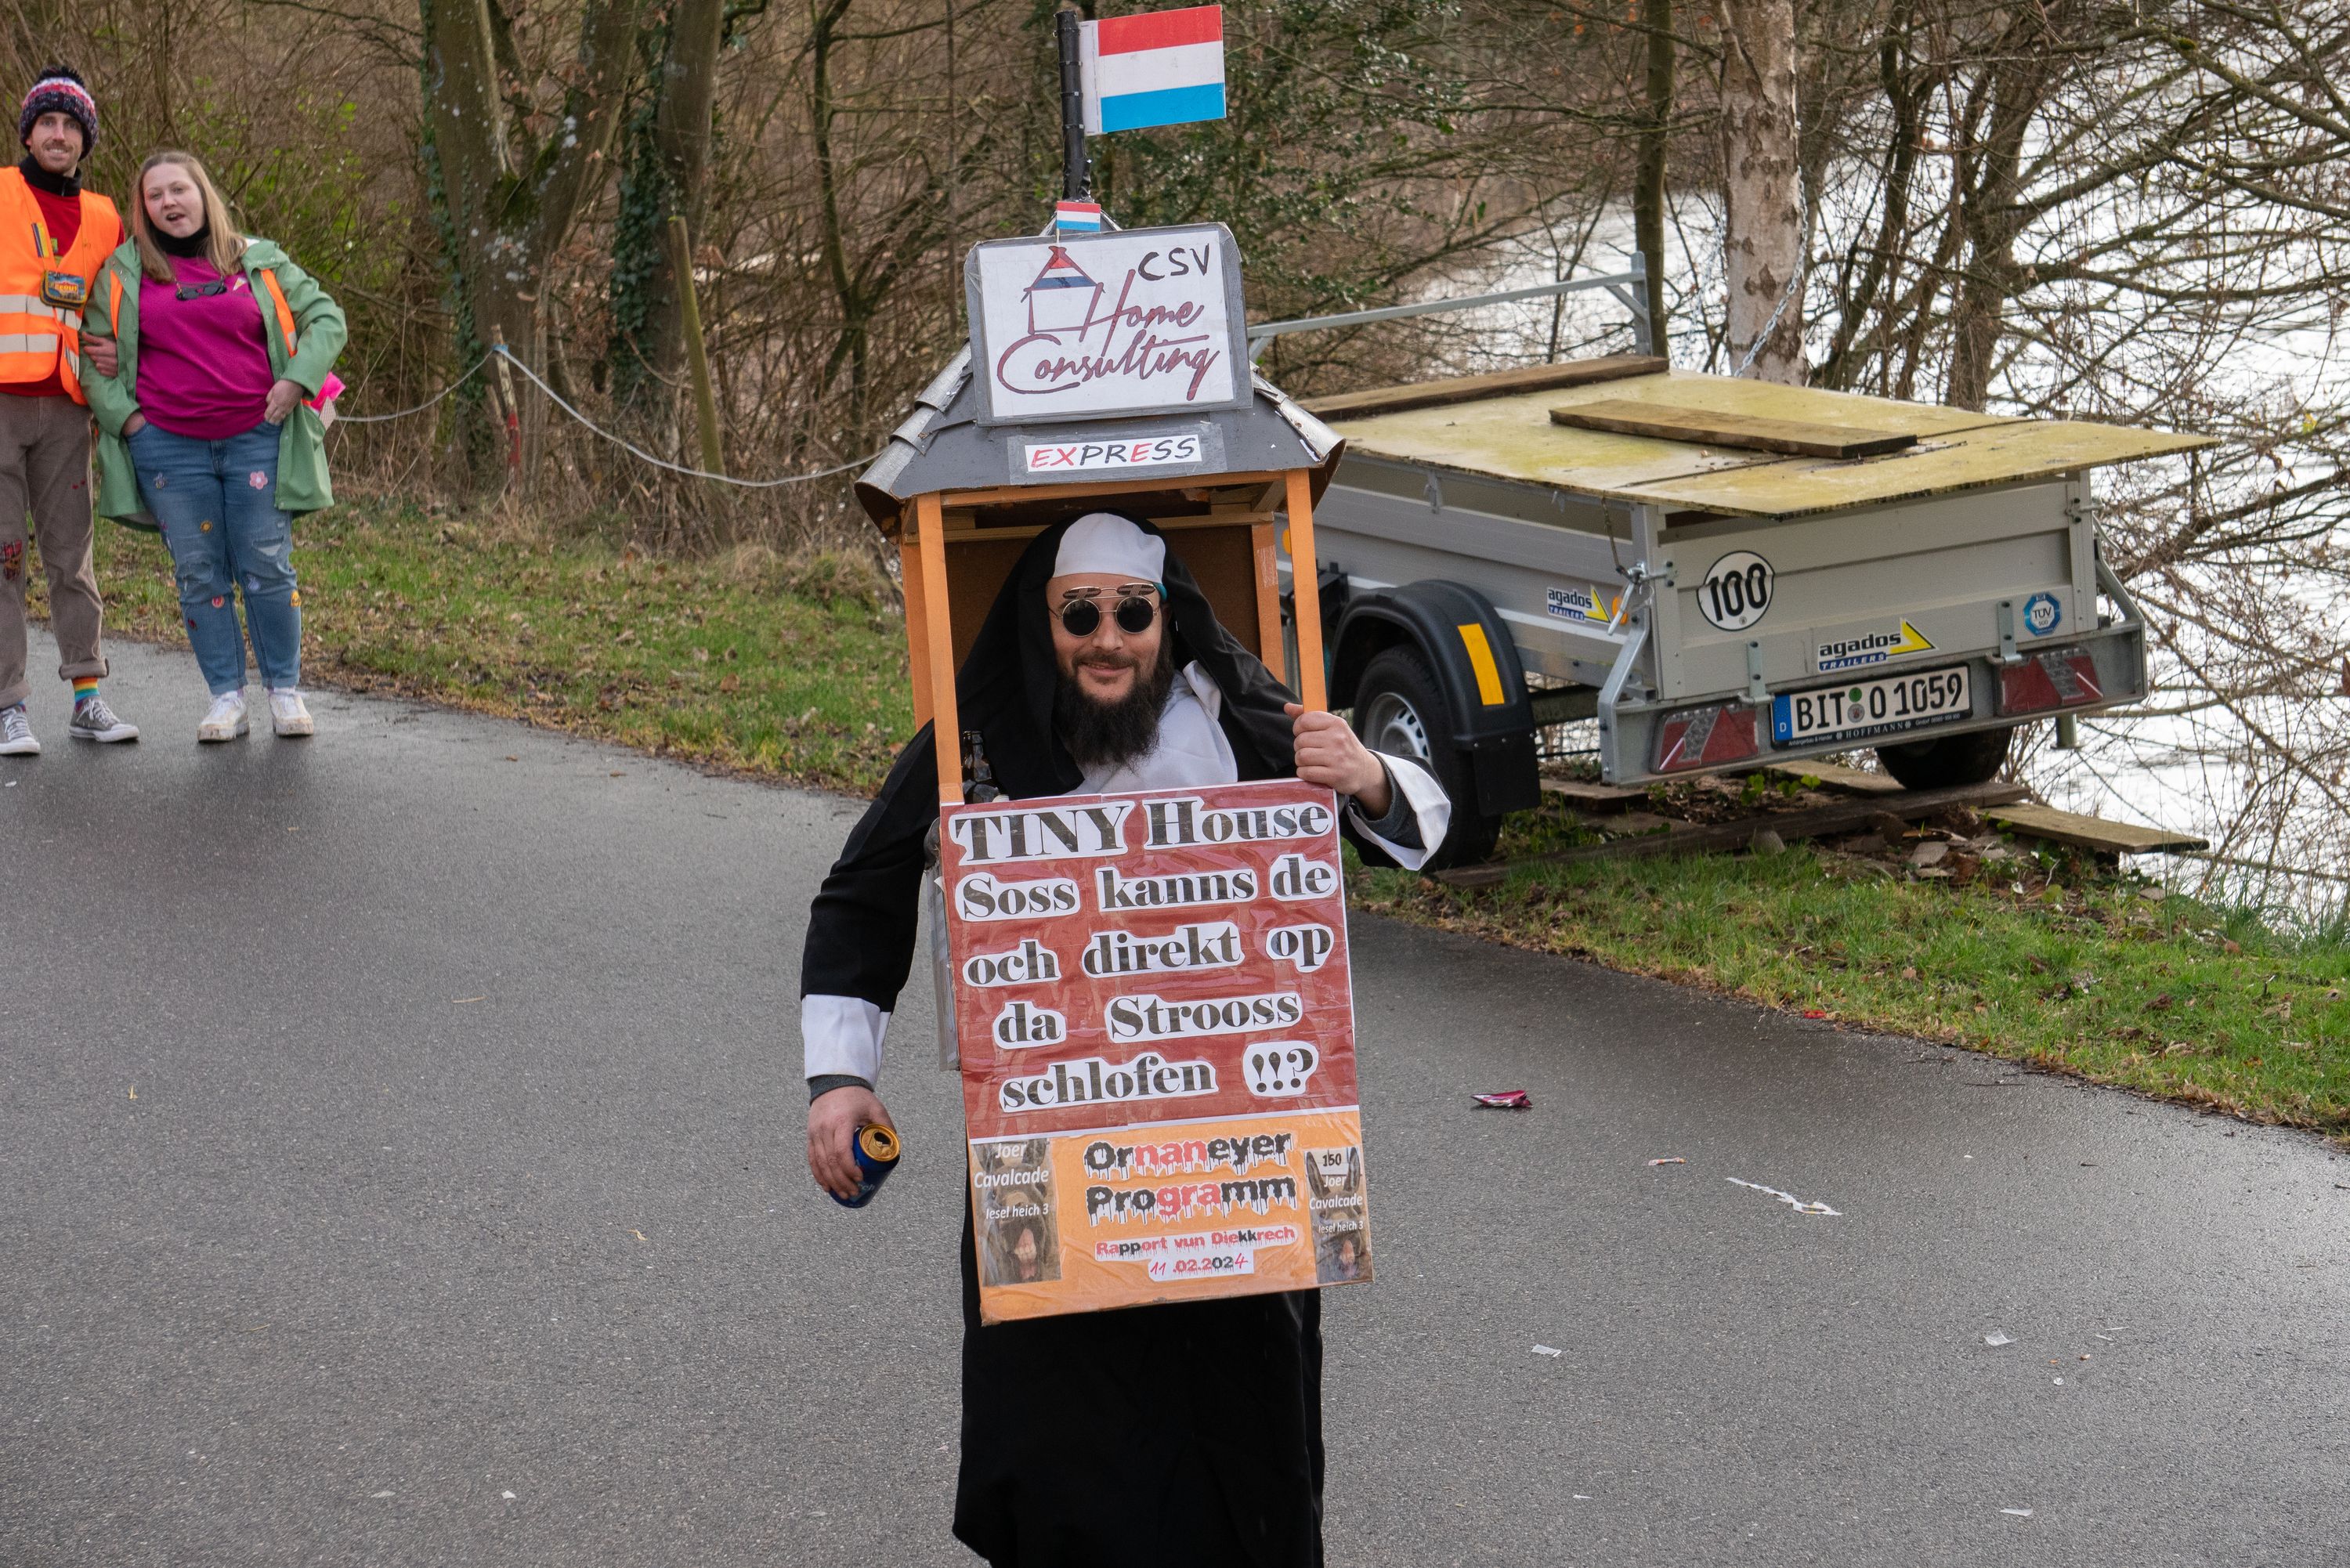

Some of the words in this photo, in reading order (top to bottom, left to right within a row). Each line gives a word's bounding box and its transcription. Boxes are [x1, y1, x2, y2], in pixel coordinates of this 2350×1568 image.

[1137, 243, 1210, 281] CSV
[1079, 269, 1205, 357] Home
[996, 329, 1220, 401] Consulting
[1031, 435, 1195, 468] EXPRESS
[1548, 588, 1593, 609] agados
[1708, 562, 1767, 623] 100
[1820, 633, 1901, 659] agados
[1821, 652, 1885, 670] TRAILERS
[1796, 691, 1846, 732] BIT
[1894, 673, 1962, 716] 1059
[1779, 721, 1787, 733] D
[1846, 721, 1904, 739] HOFFMANN
[955, 804, 1129, 862] TINY
[1146, 798, 1331, 845] House
[962, 878, 1077, 917] Soss
[1097, 868, 1256, 909] kanns
[1272, 856, 1332, 898] de
[967, 939, 1058, 985] och
[1083, 924, 1241, 976] direkt
[1270, 927, 1332, 969] op
[997, 1003, 1062, 1044] da
[1109, 993, 1300, 1038] Strooss
[1002, 1055, 1214, 1107] schlofen
[1252, 1047, 1314, 1093] !!?
[995, 1143, 1028, 1159] Joer
[1084, 1133, 1292, 1178] Ornaneyer
[1322, 1152, 1342, 1167] 150
[974, 1165, 1050, 1189] Cavalcade
[1324, 1176, 1347, 1187] Joer
[1012, 1203, 1039, 1217] heich
[1043, 1203, 1050, 1216] 3
[1086, 1176, 1297, 1227] Programm
[1309, 1193, 1363, 1210] Cavalcade
[1336, 1220, 1357, 1233] heich
[1358, 1220, 1364, 1230] 3
[1096, 1237, 1168, 1259] Rapport
[1174, 1235, 1206, 1253] vun
[1211, 1227, 1295, 1248] Diekkrech
